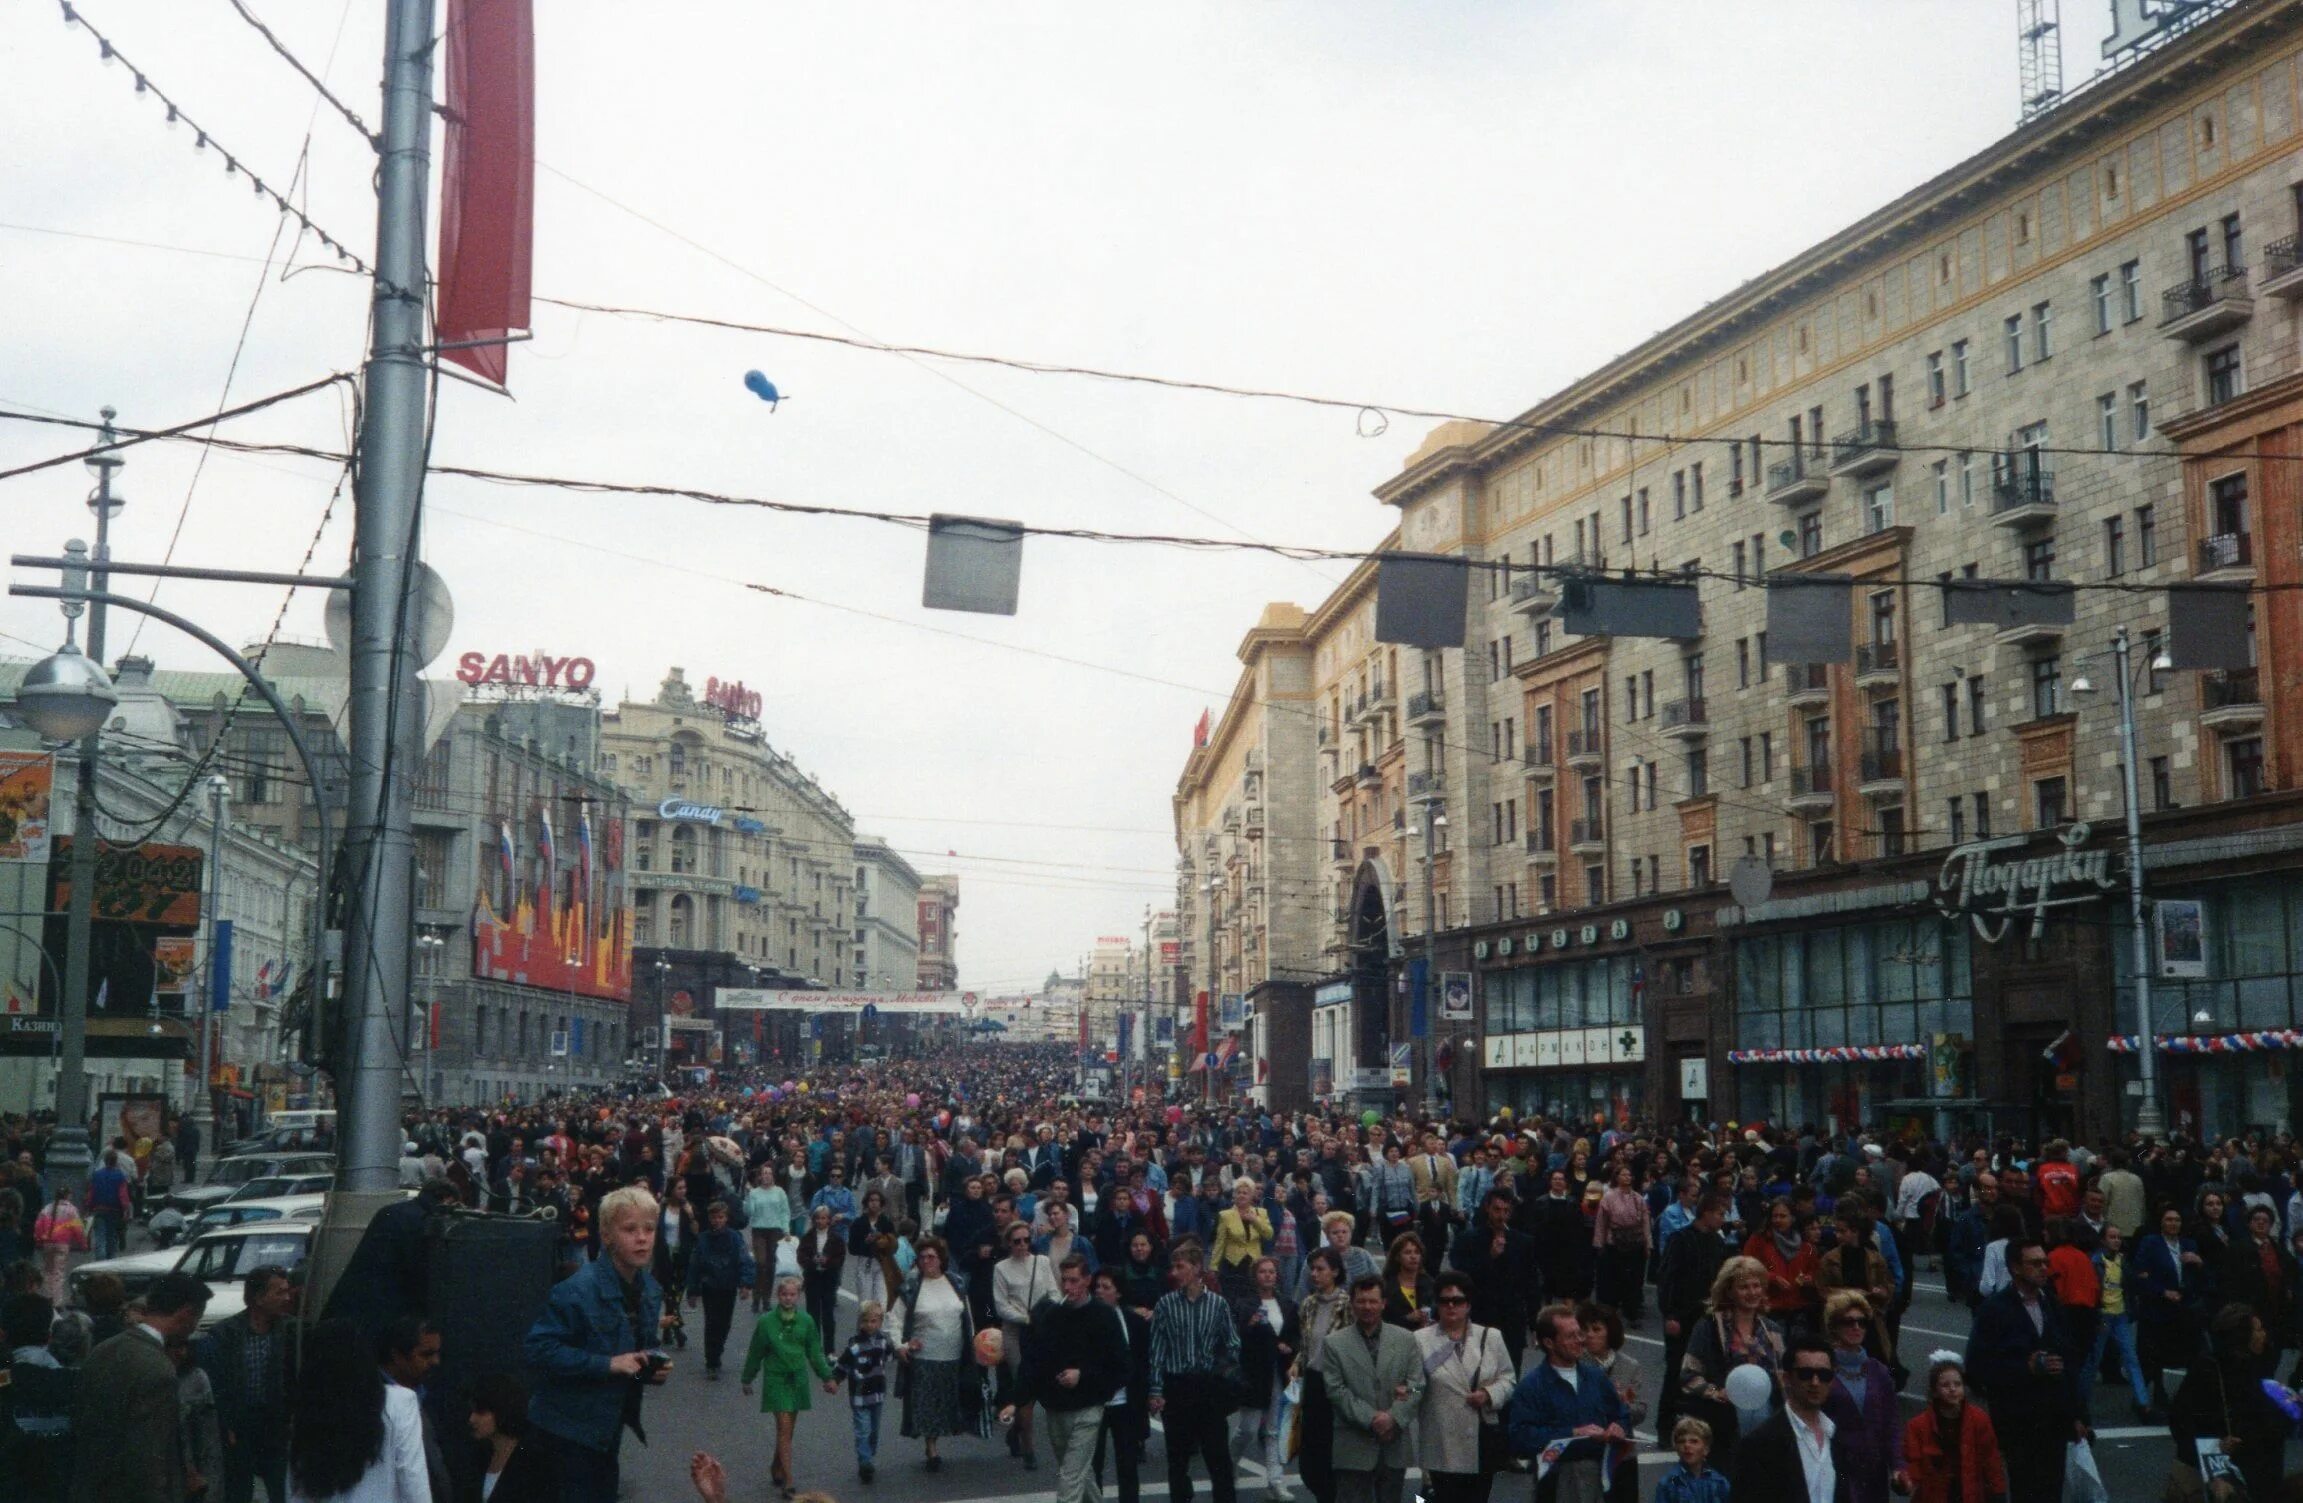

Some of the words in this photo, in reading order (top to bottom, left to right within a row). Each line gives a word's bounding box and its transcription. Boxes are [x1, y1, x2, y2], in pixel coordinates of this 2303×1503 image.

[456, 651, 595, 688] SANYO
[659, 794, 722, 824] Candy
[1934, 822, 2116, 942] Подарки
[1475, 920, 1627, 958] АПТЕКА
[1518, 1039, 1608, 1055] ФАРМАКОН
